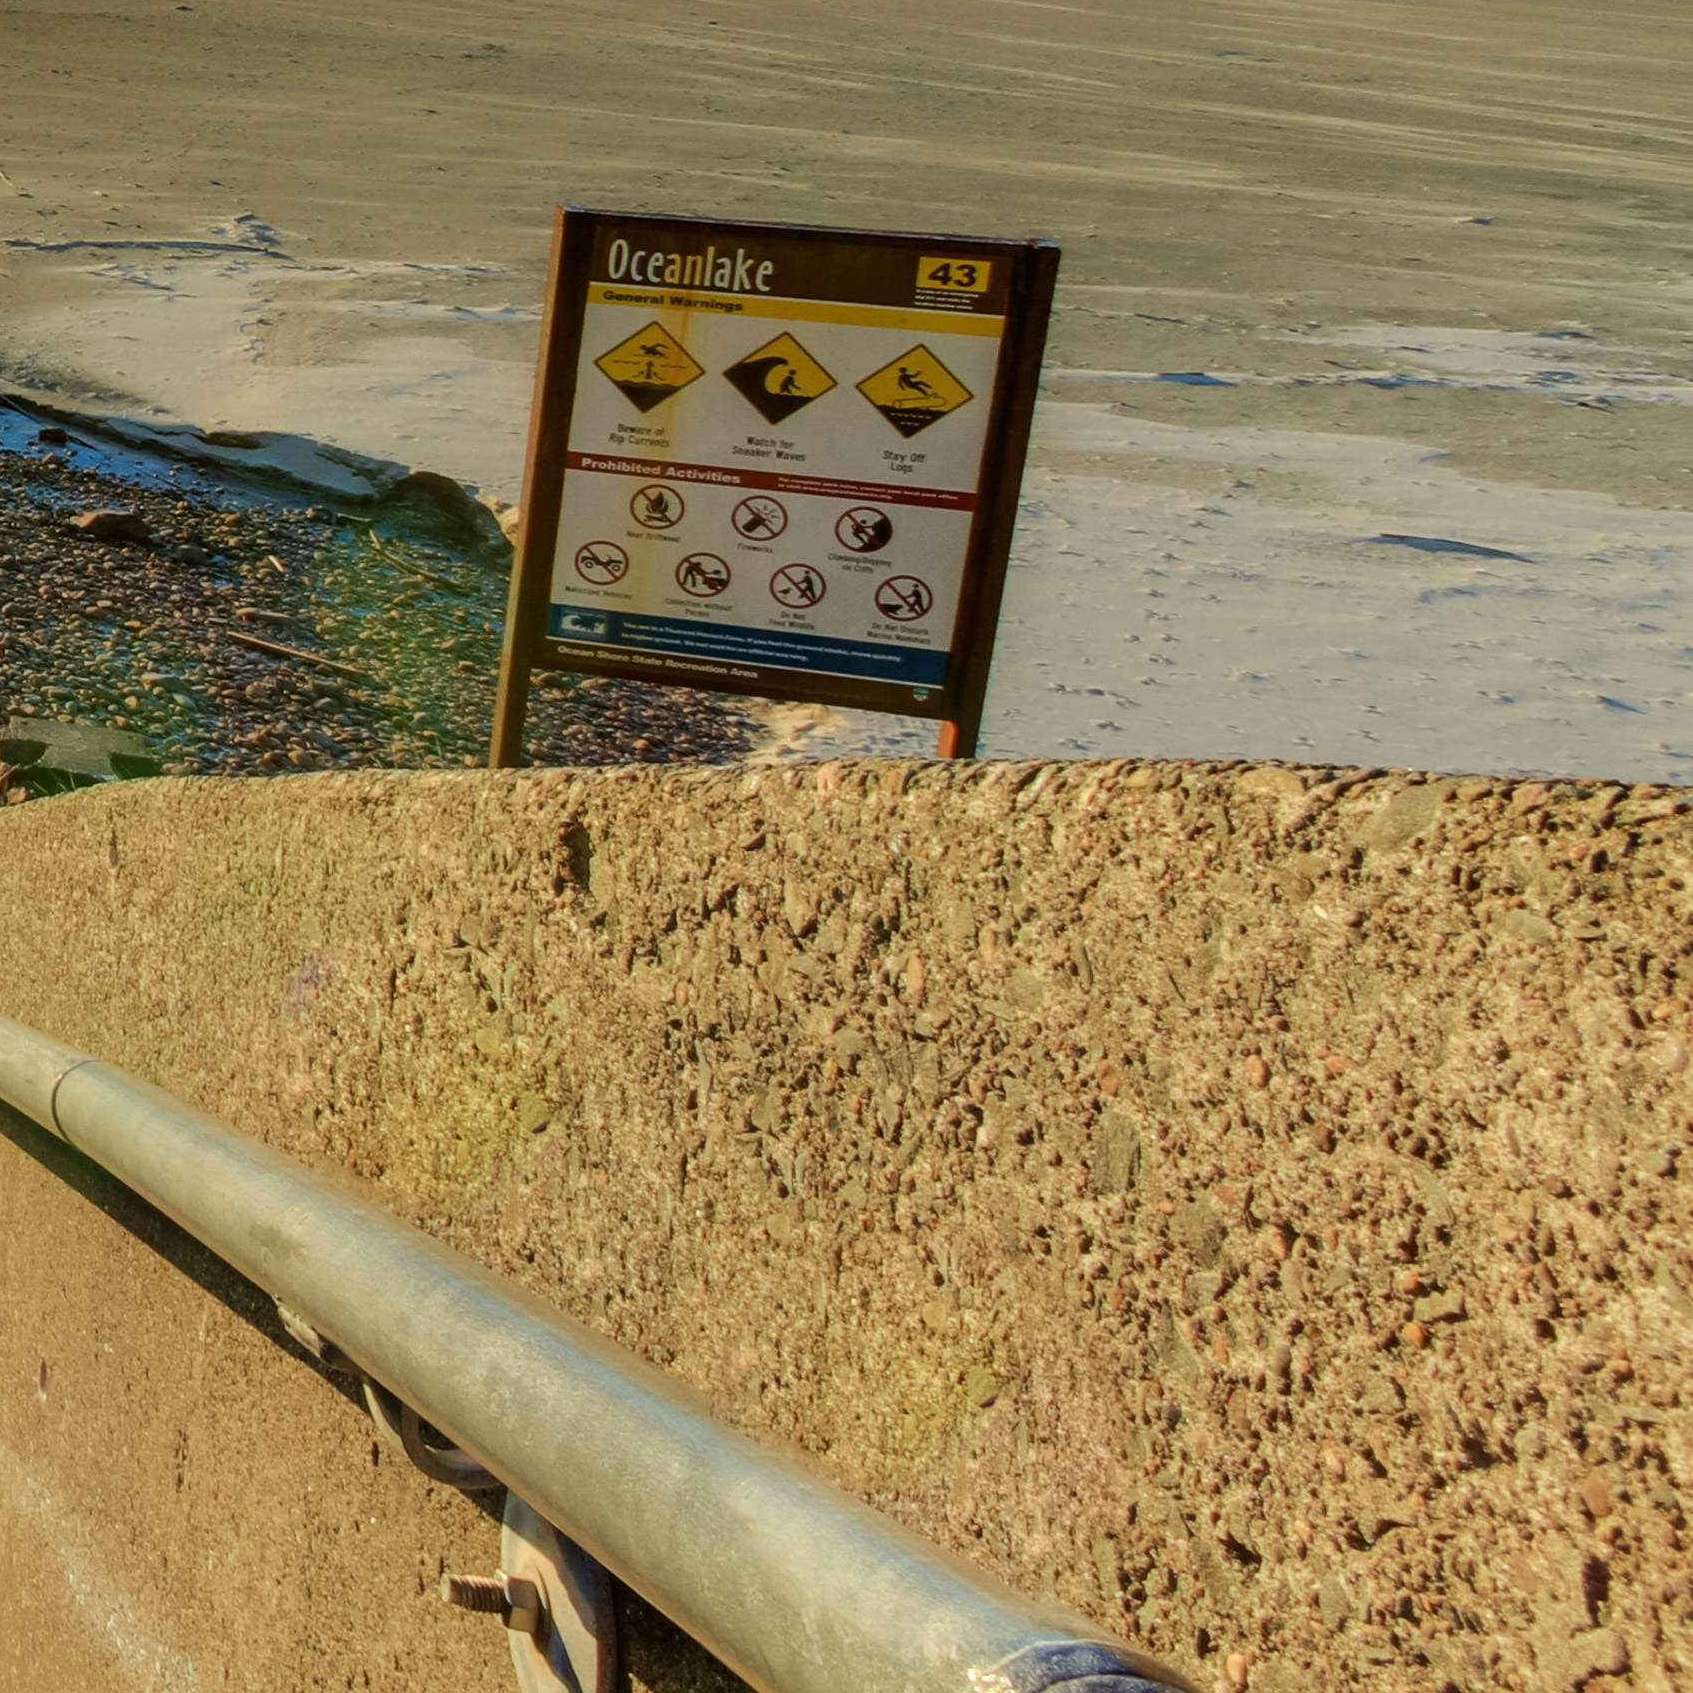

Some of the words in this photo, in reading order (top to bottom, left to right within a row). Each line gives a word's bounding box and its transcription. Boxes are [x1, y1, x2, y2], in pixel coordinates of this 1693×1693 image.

[608, 239, 774, 292] Oceanlake
[928, 263, 977, 287] 43
[603, 290, 664, 305] General
[670, 295, 743, 312] Warnings
[747, 437, 777, 448] Watch
[776, 450, 806, 461] Waves
[882, 450, 906, 462] Stay
[581, 457, 661, 475] Prohibited
[665, 466, 741, 483] Activities
[890, 462, 913, 474] Logs
[557, 645, 595, 657] Ocean
[596, 649, 630, 662] Shore
[632, 654, 662, 666] State
[665, 659, 727, 675] Recreation
[730, 668, 758, 678] Area
